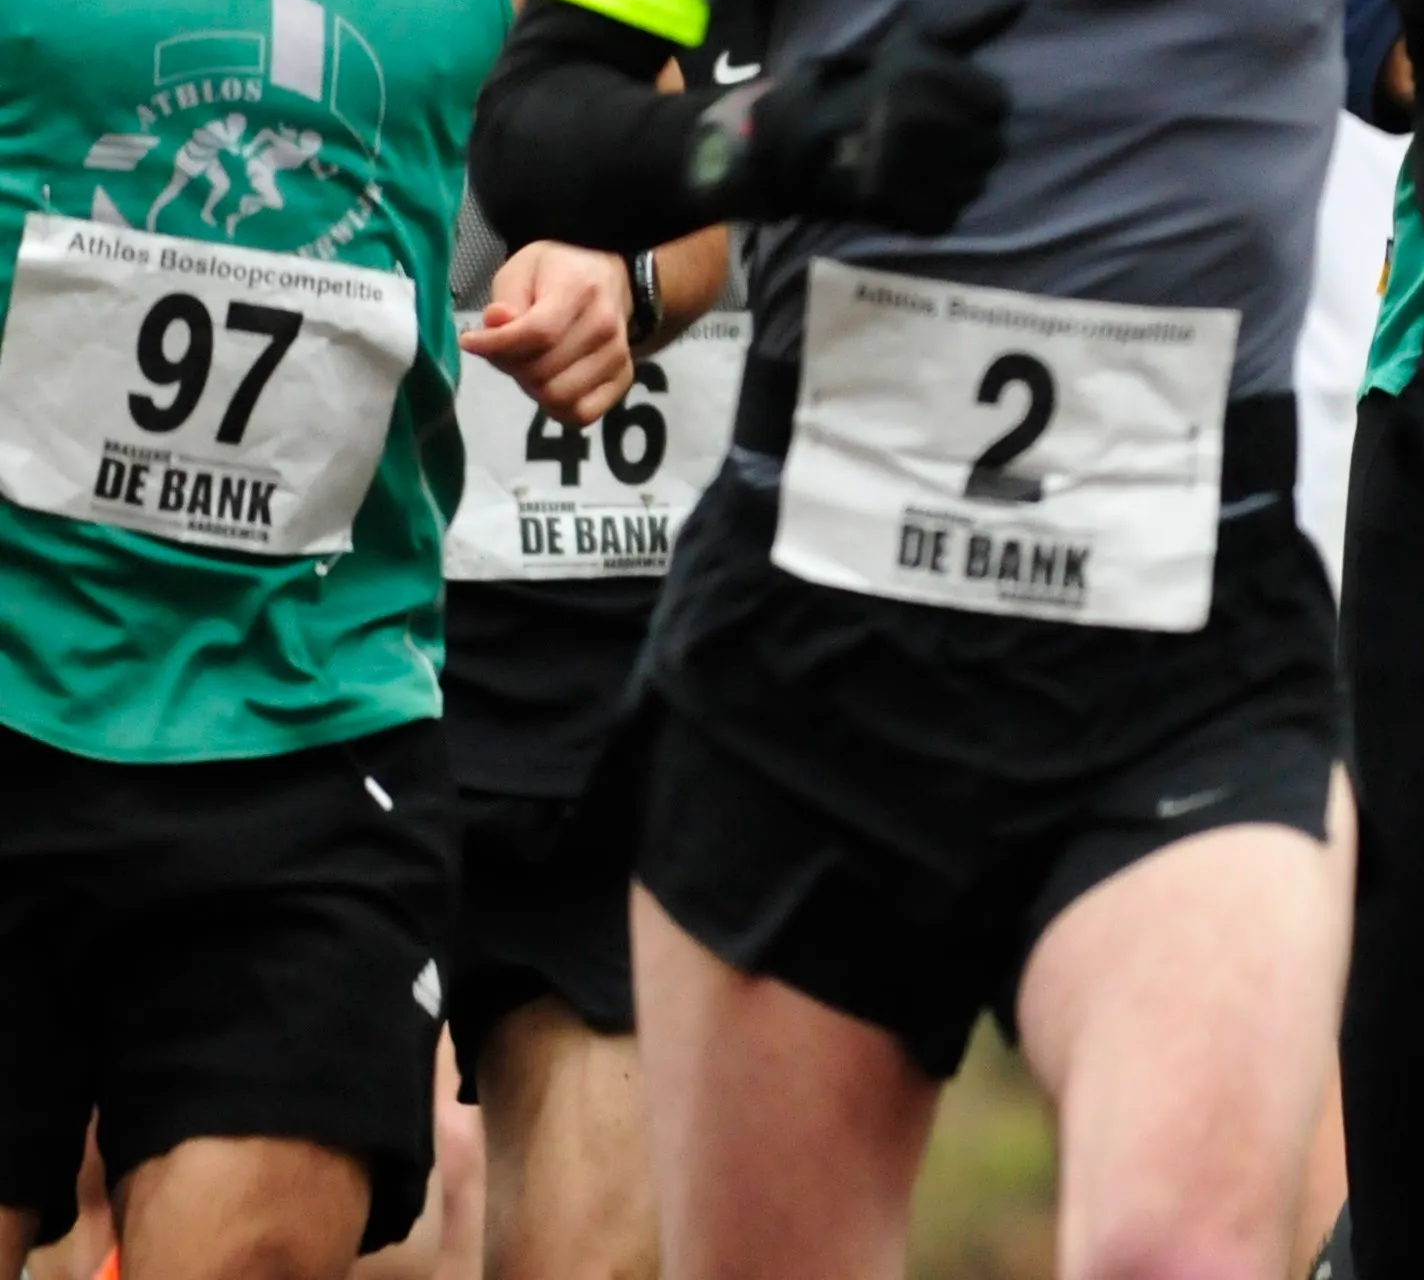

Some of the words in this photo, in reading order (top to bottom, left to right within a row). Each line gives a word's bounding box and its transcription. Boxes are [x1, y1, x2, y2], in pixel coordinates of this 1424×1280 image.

[136, 77, 263, 134] ATHLOS
[68, 232, 150, 265] Athlos
[160, 248, 384, 303] Bosloopcompetitie
[127, 292, 304, 446] 97
[525, 361, 669, 486] 46
[963, 350, 1056, 502] 2
[94, 457, 150, 506] DE
[158, 468, 277, 526] BANK
[520, 517, 565, 554] DE
[575, 516, 669, 555] BANK
[900, 525, 948, 573] DE
[966, 535, 1090, 589] BANK
